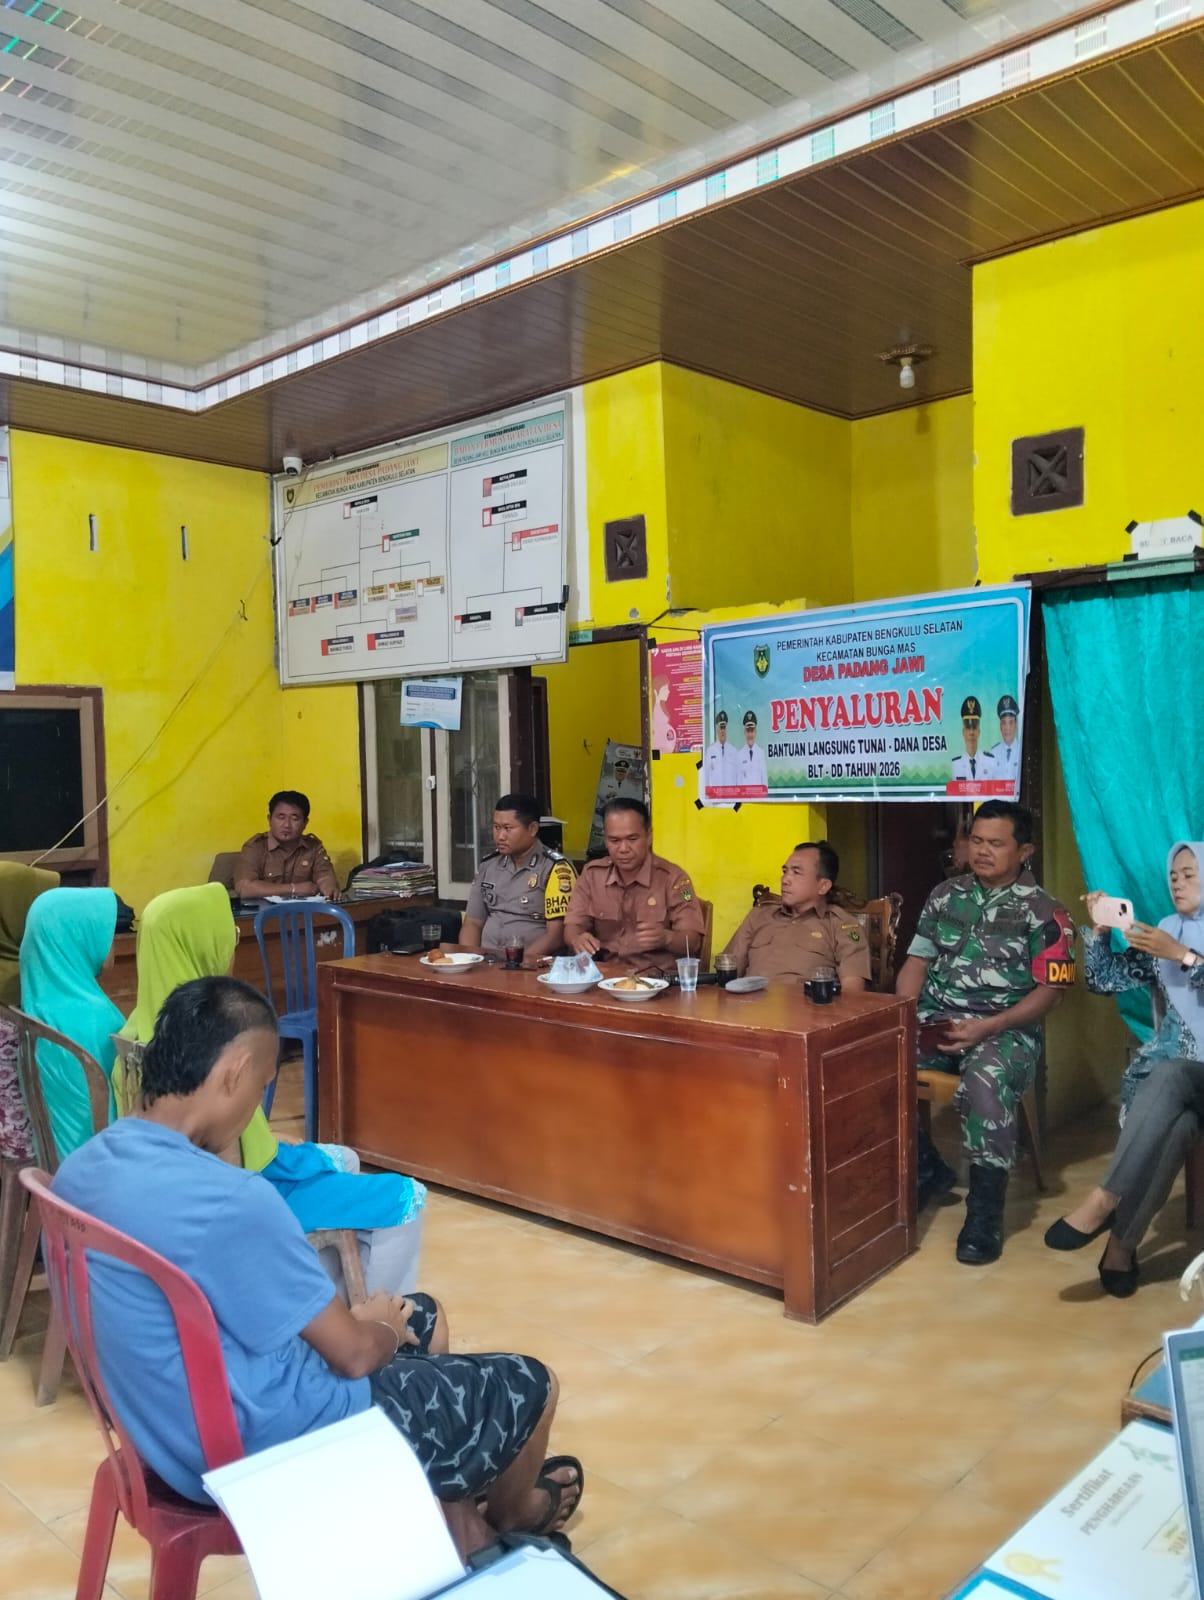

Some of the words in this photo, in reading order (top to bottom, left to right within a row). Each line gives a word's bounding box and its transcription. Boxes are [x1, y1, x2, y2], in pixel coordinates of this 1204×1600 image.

[777, 637, 824, 651] PEMERINTAH
[825, 632, 873, 646] KABUPATEN
[874, 626, 921, 640] BENGKULU
[923, 620, 963, 635] SELATAN
[816, 647, 865, 662] KECAMATAN
[866, 644, 896, 657] BUNGA
[897, 642, 916, 654] MAS
[803, 663, 835, 683] DESA
[838, 658, 889, 680] PADANG
[892, 655, 925, 674] JAWI
[770, 687, 943, 732] PENYALURAN
[768, 743, 806, 757] BANTUAN
[808, 740, 855, 756] LANGSUNG
[857, 737, 886, 753] TUNAI
[894, 737, 920, 752] DANA
[922, 735, 947, 751] DESA
[808, 764, 823, 778] BLT
[831, 763, 843, 777] DD
[845, 762, 877, 777] TAHUN
[879, 761, 900, 776] 2026
[546, 895, 571, 908] BHA
[1060, 1468, 1114, 1518] Sertifikat
